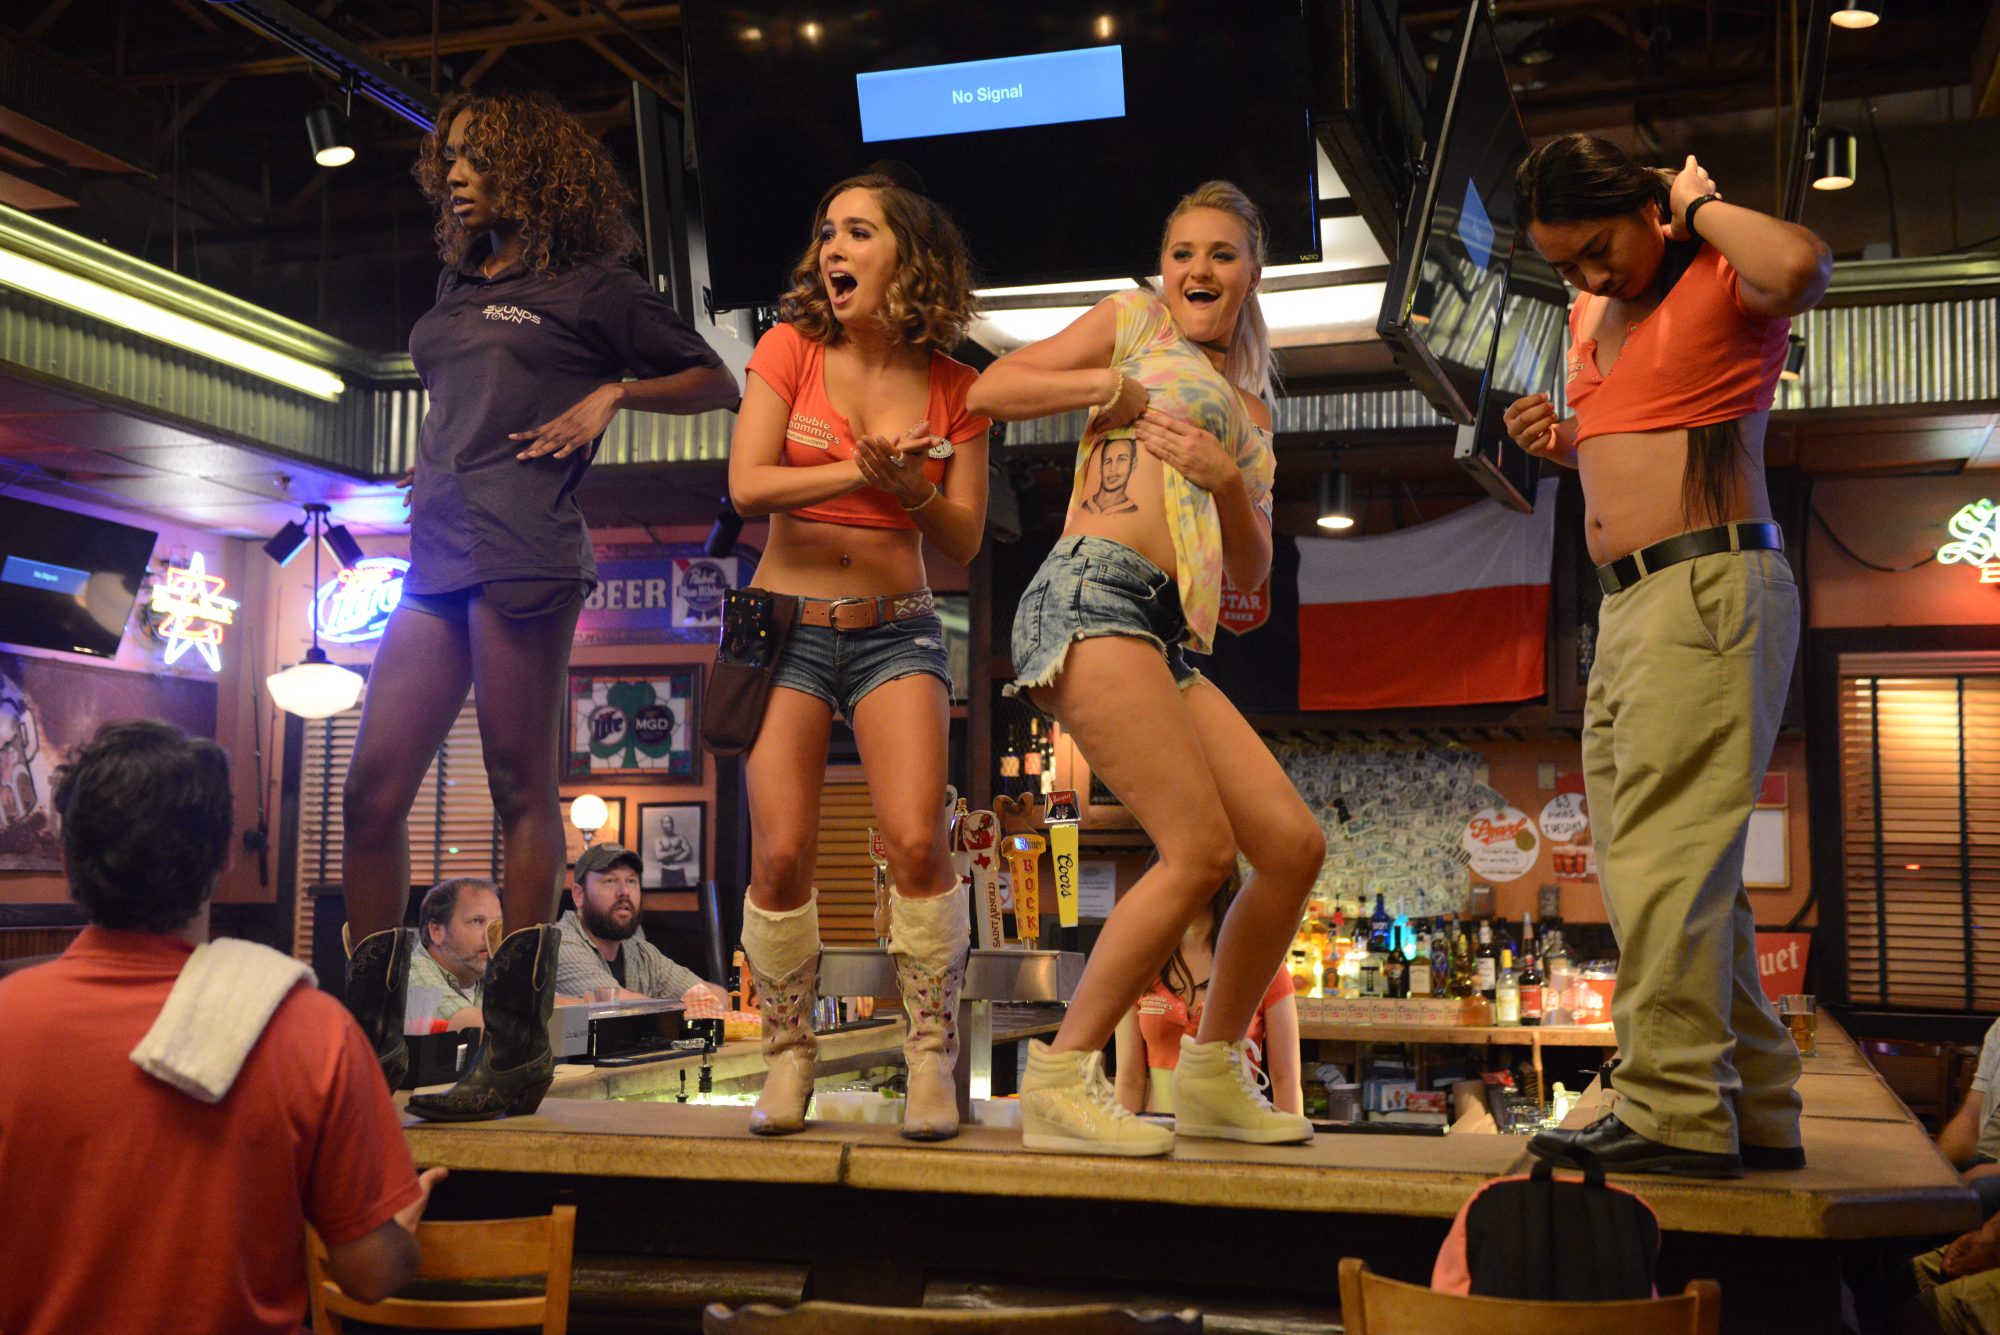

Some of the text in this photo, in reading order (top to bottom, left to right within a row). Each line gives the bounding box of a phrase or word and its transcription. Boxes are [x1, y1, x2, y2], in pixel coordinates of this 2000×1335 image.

[952, 83, 1023, 104] No Signal
[482, 310, 523, 324] TOWN
[484, 305, 541, 325] SOUNDS
[793, 410, 831, 431] double
[584, 578, 667, 610] BEER
[636, 718, 669, 731] MGD
[1057, 853, 1074, 899] Coors
[1023, 858, 1038, 931] BOCK
[988, 882, 1001, 949] SAINT ARNOLD
